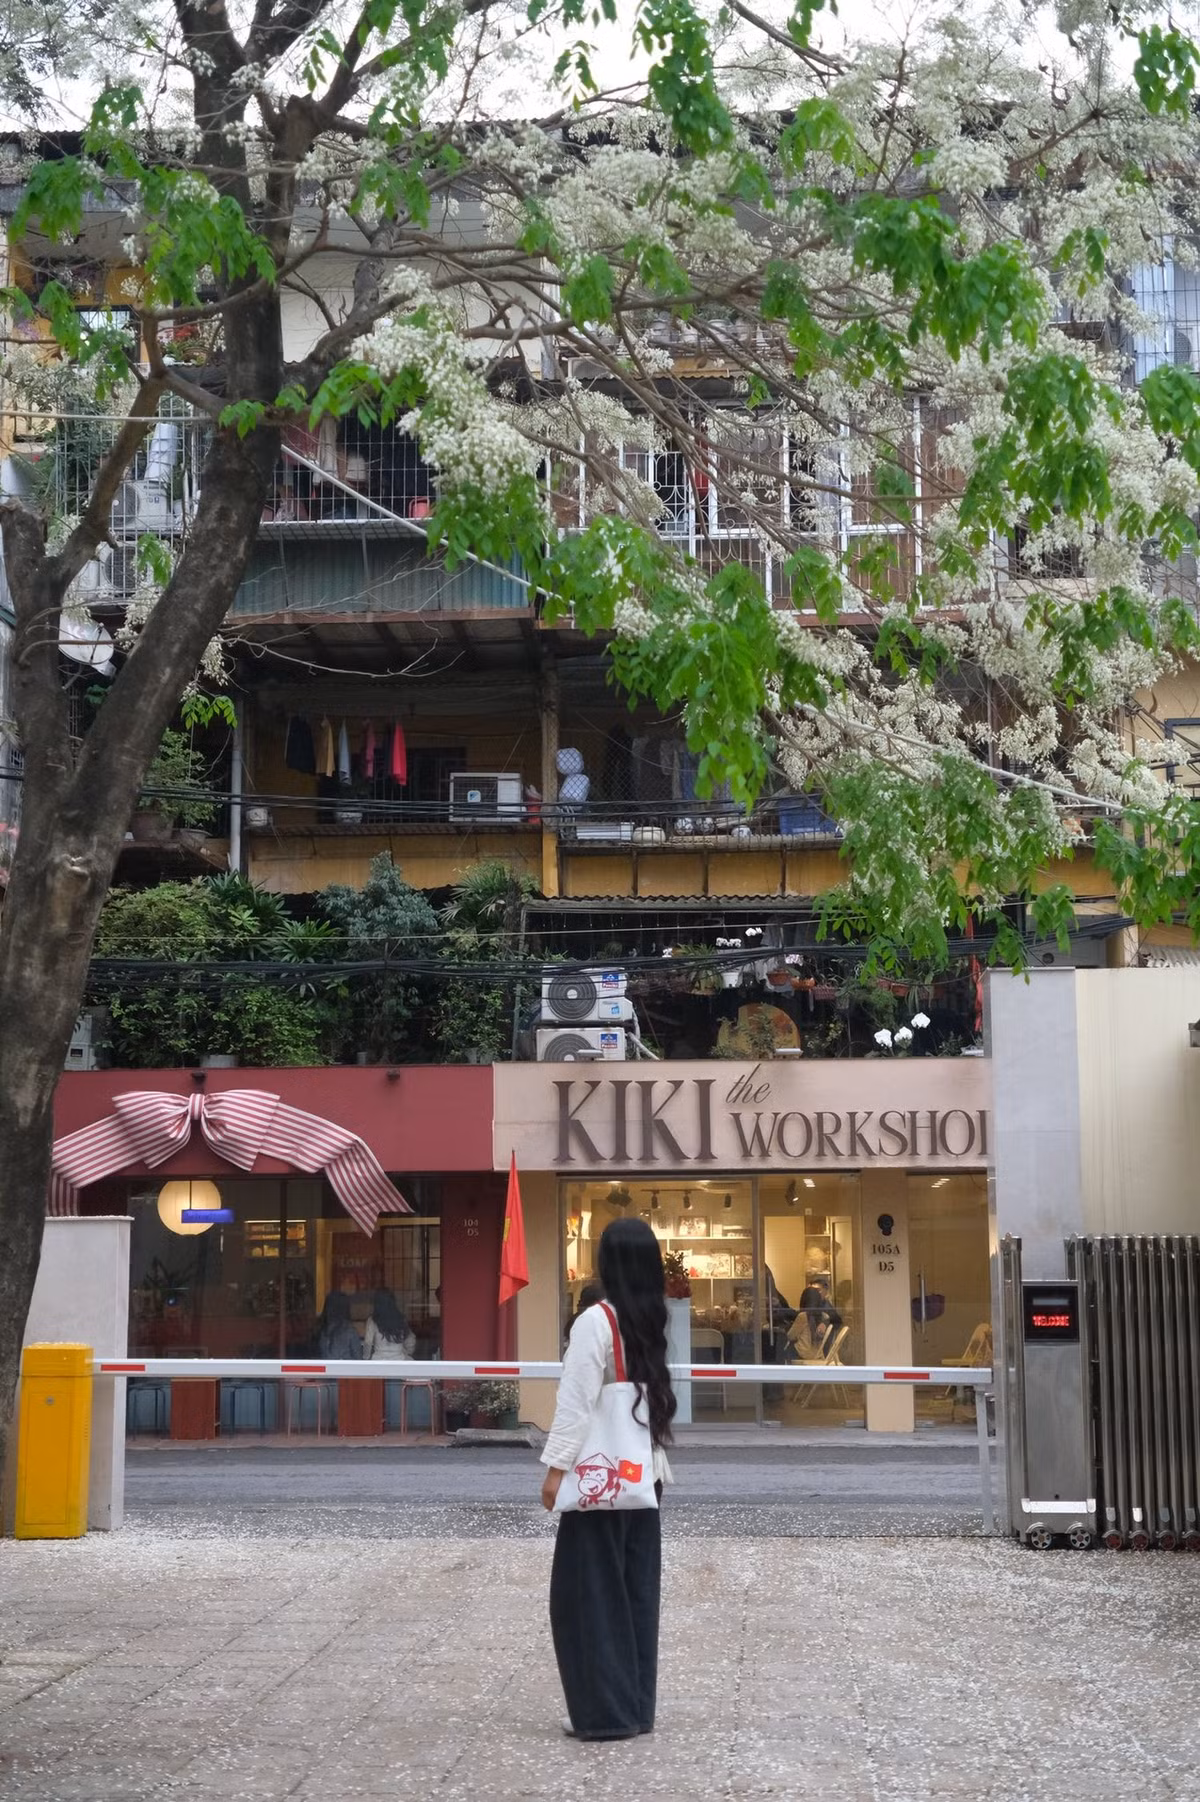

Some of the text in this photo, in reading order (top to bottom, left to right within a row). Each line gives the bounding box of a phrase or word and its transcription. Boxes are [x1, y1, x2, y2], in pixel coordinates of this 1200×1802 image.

[725, 1063, 771, 1104] the
[552, 1079, 718, 1161] KIKI
[872, 1243, 900, 1255] 105A
[879, 1261, 895, 1272] D5
